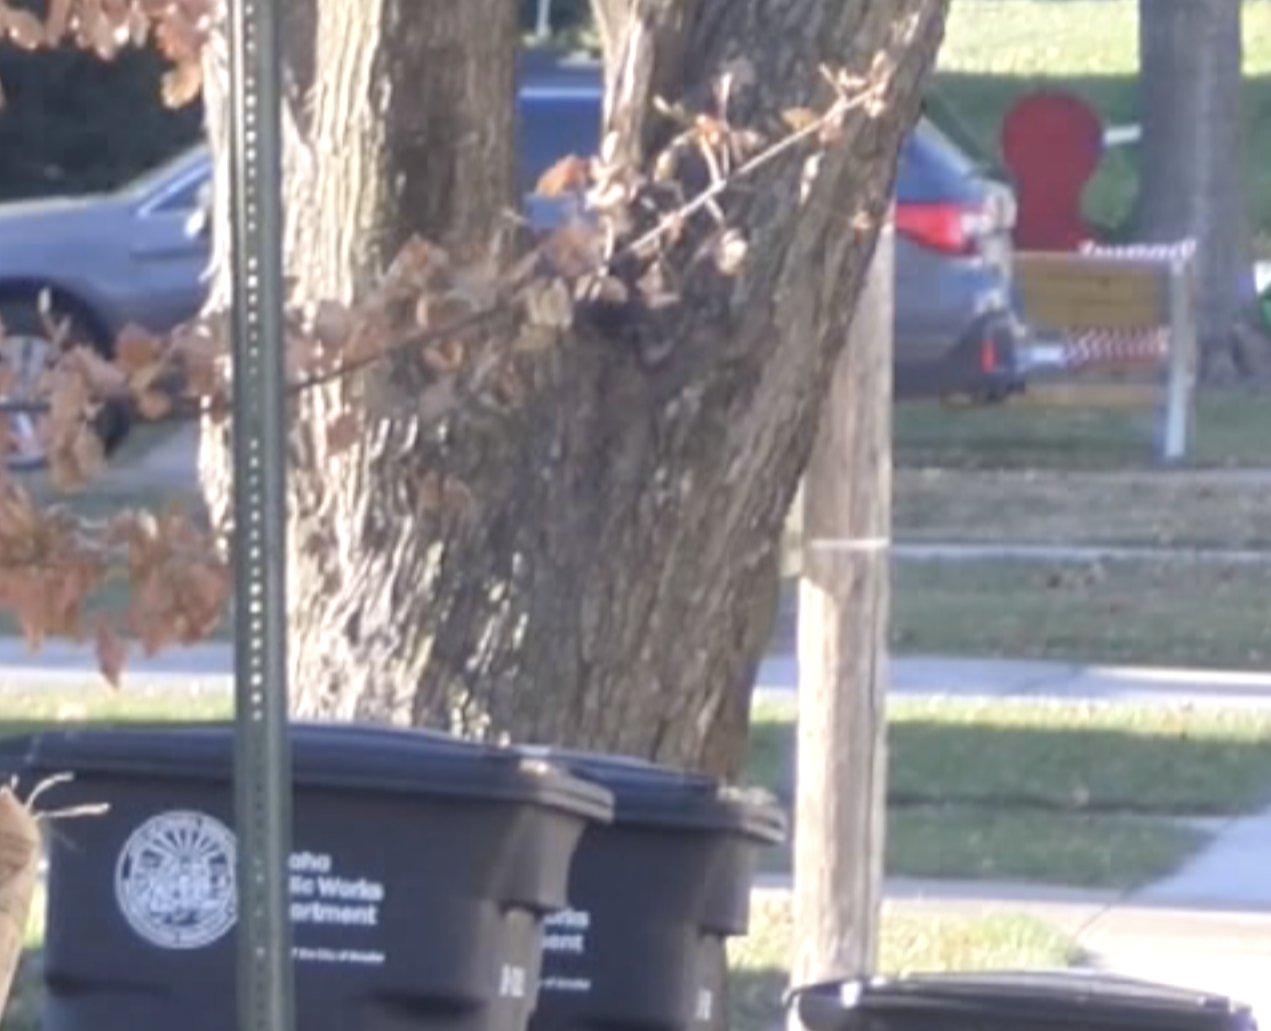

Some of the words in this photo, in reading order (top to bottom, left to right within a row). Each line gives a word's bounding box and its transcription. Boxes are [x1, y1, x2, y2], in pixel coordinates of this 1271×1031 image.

[289, 851, 331, 872] aha
[318, 876, 385, 901] Works
[290, 900, 378, 925] artment
